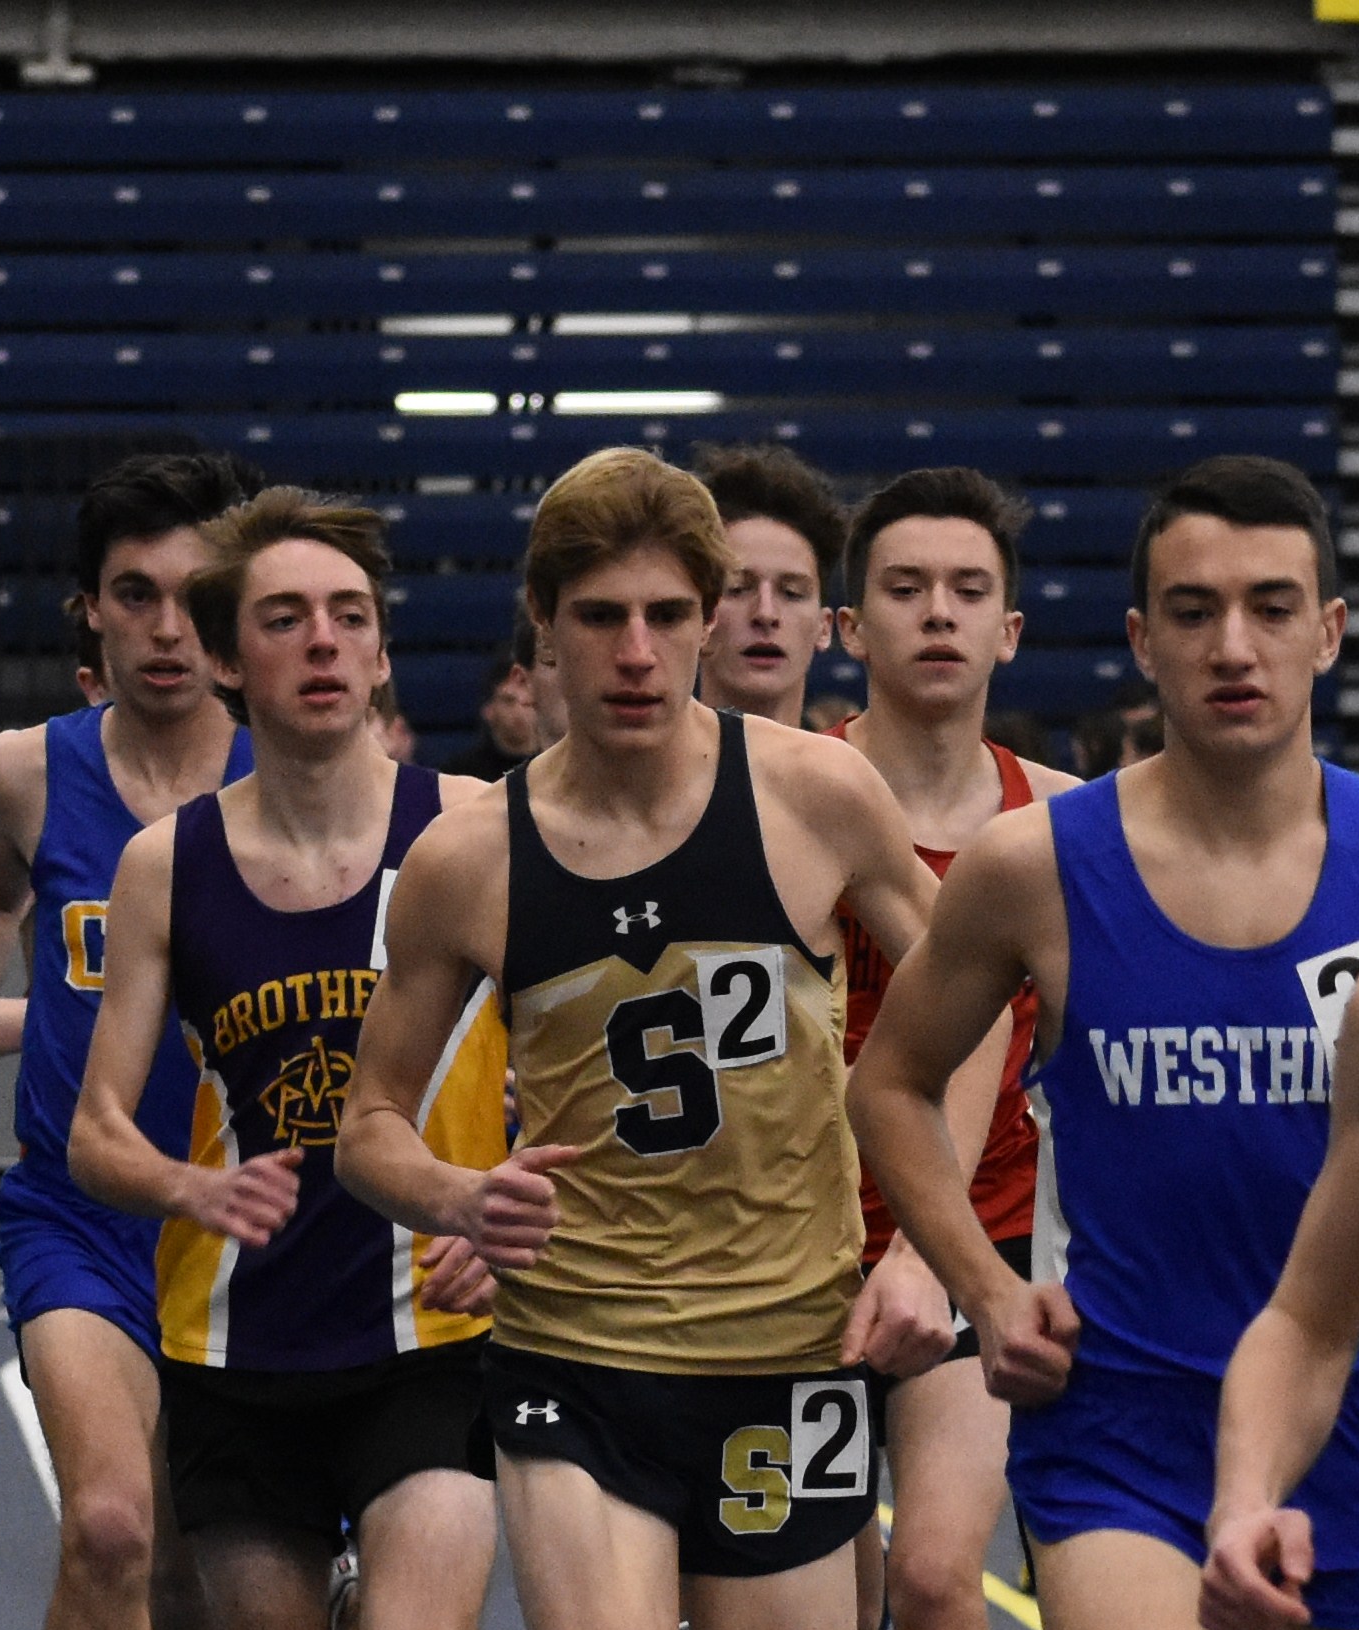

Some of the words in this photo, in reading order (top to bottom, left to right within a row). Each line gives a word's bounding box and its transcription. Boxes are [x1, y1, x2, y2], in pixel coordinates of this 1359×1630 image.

[604, 987, 723, 1157] S
[710, 960, 777, 1060] 2
[718, 1425, 792, 1534] S
[799, 1389, 859, 1490] 2
